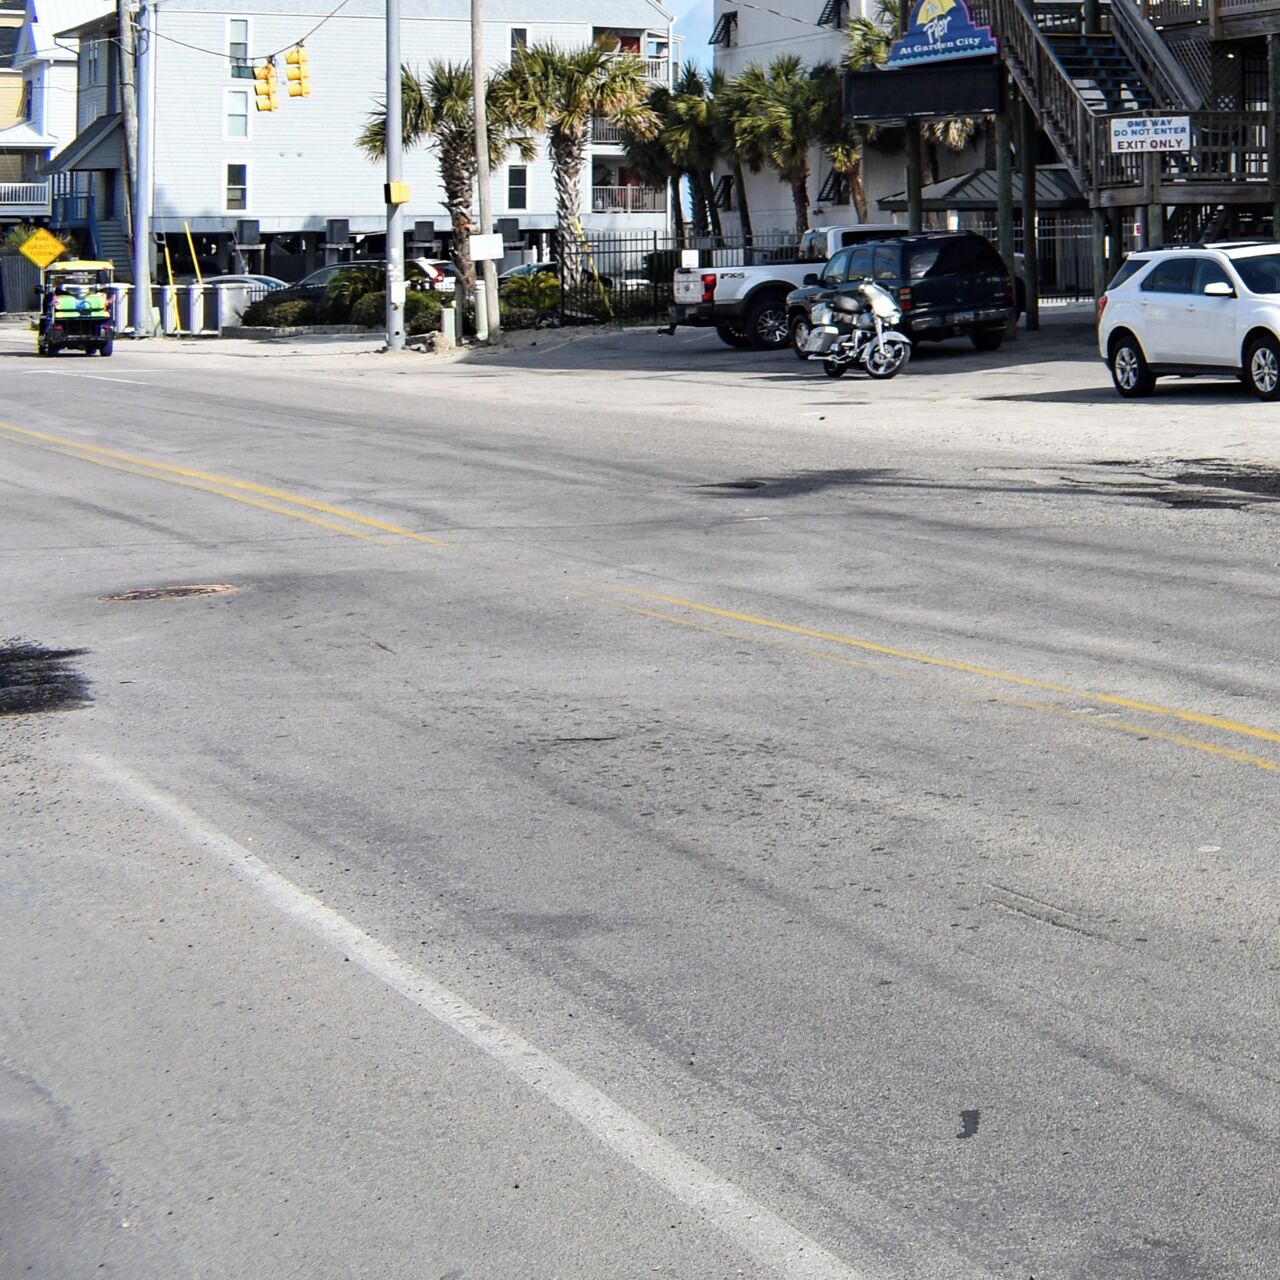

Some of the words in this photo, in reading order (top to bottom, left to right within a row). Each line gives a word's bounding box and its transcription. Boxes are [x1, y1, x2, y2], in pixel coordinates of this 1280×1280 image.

[923, 16, 952, 43] Pier
[914, 42, 954, 52] Garden
[956, 37, 982, 46] City
[1127, 120, 1148, 128] ONE
[1154, 127, 1186, 135] ENTER
[1118, 140, 1146, 150] EXIT
[1150, 138, 1184, 149] ONLY
